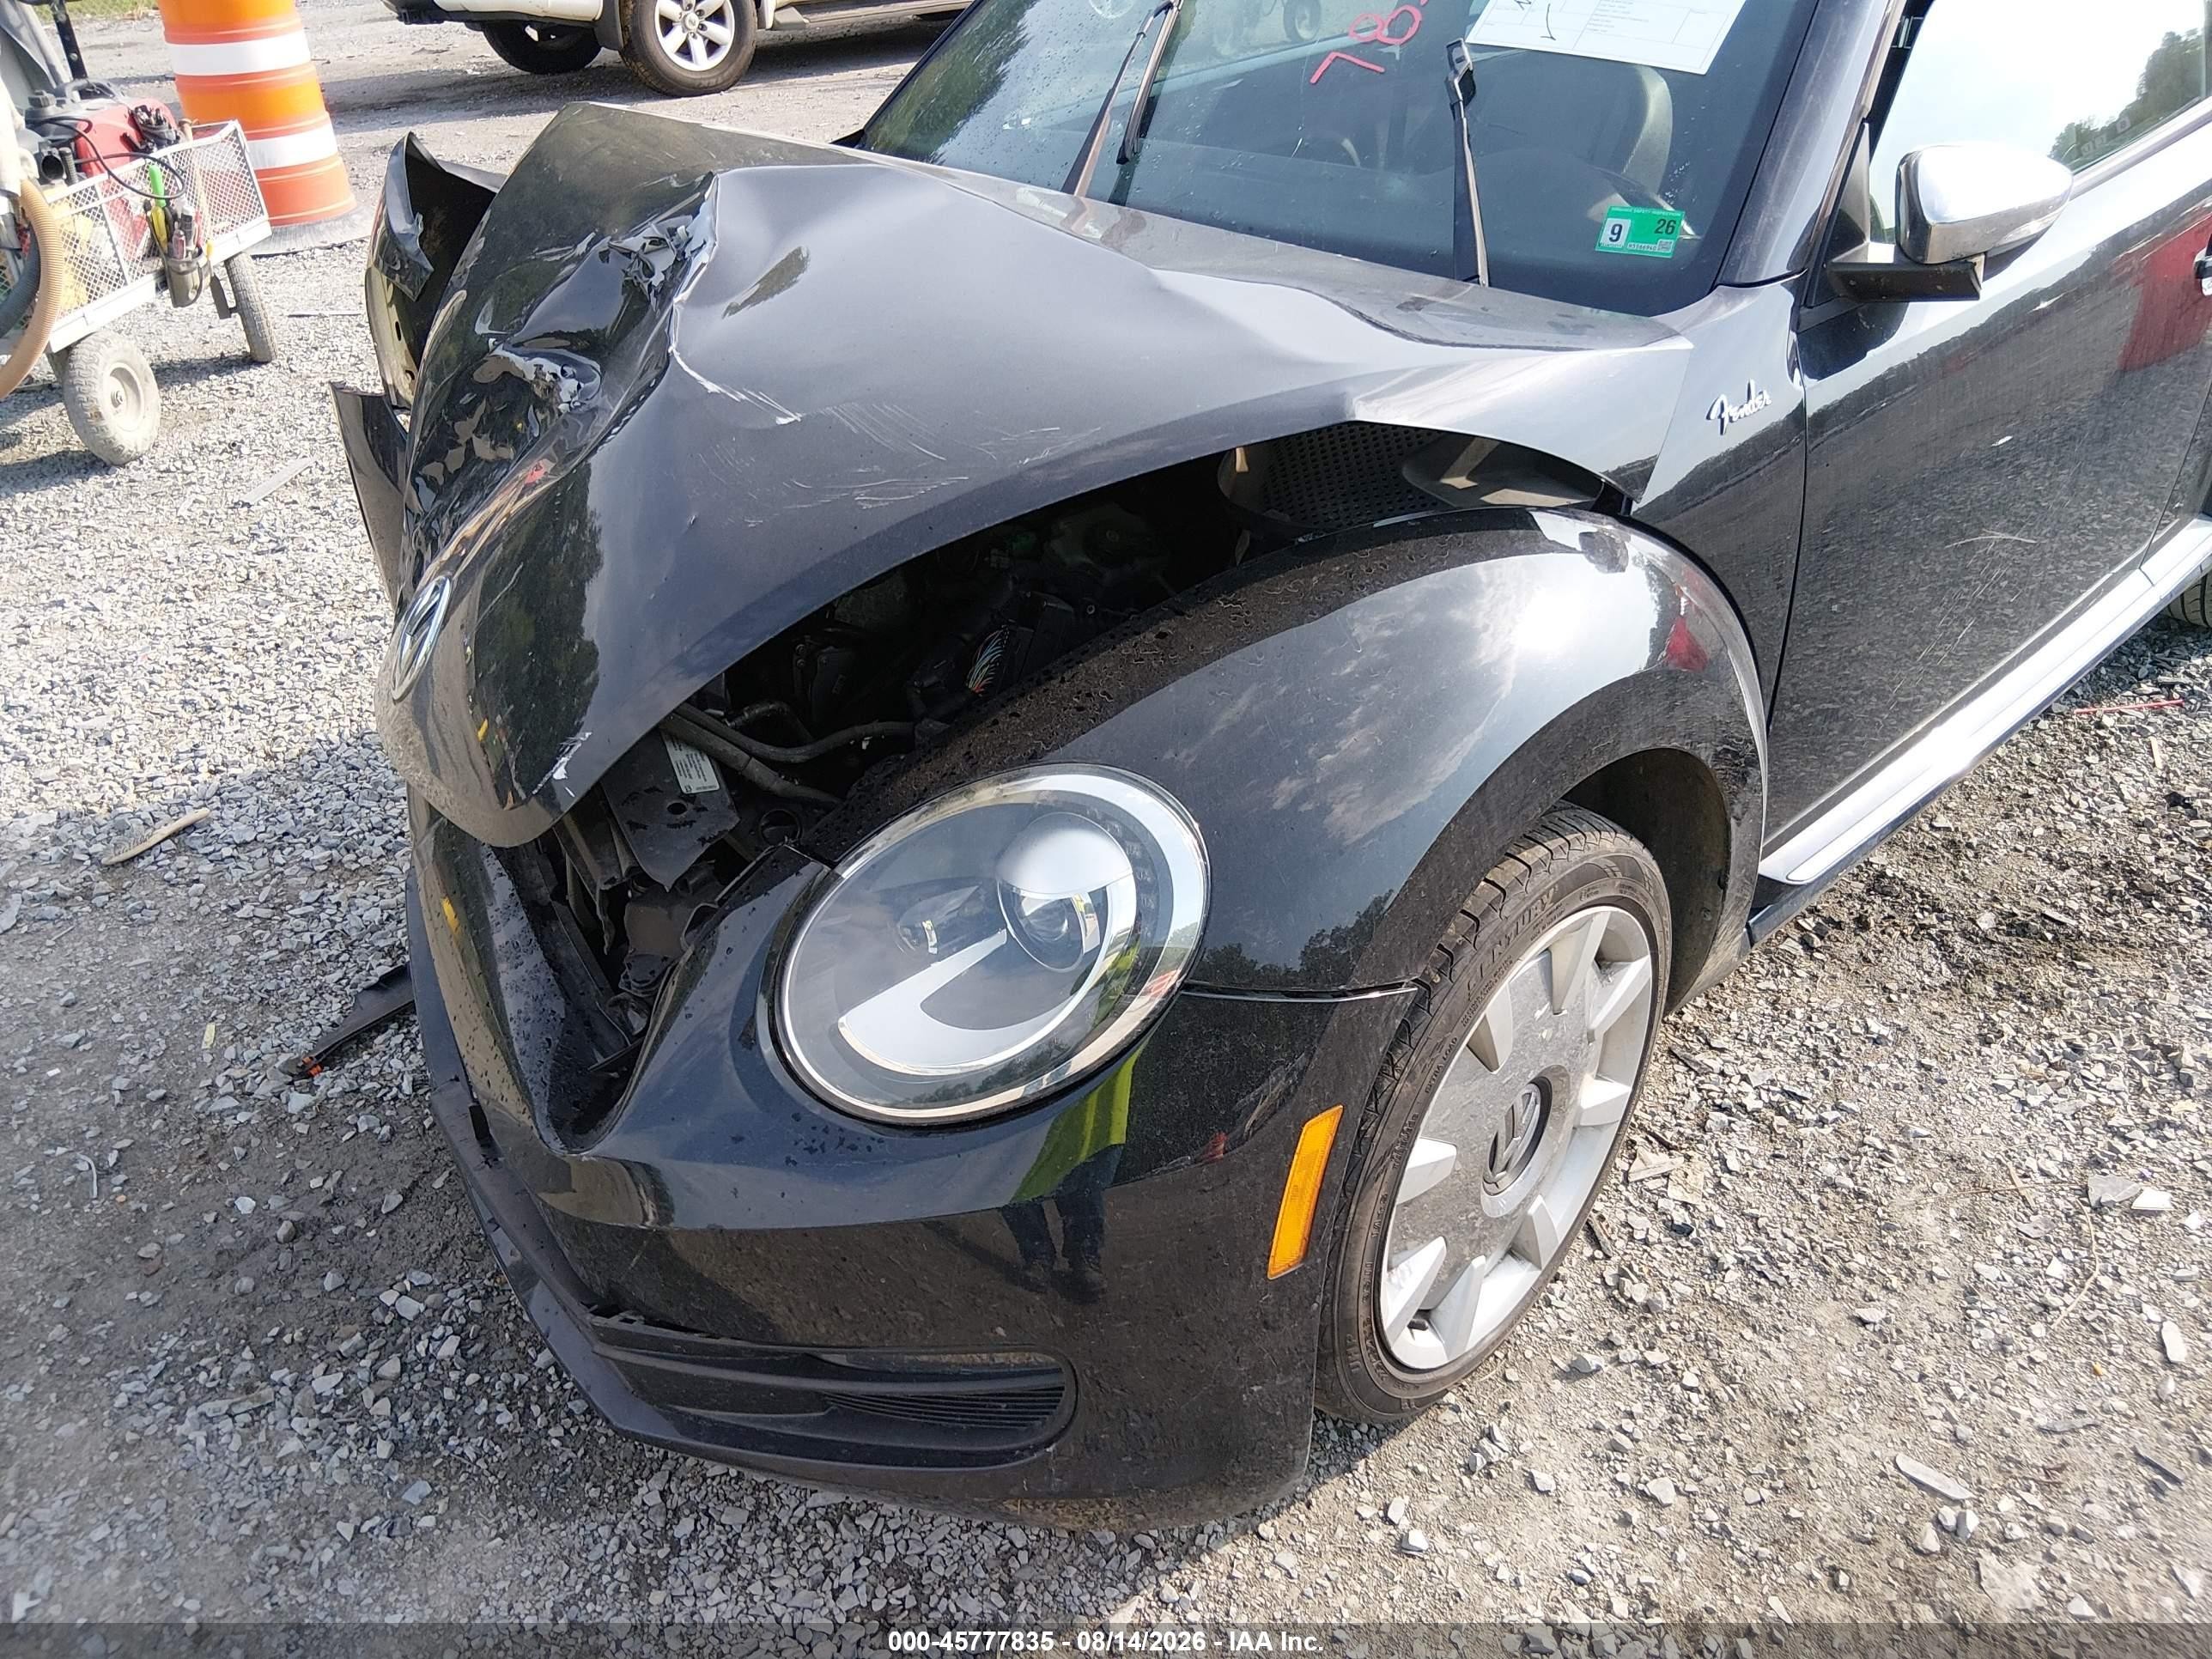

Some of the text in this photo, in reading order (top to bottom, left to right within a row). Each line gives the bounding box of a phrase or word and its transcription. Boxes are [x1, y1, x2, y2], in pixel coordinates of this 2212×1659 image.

[1608, 218, 1677, 242] 9 26
[1705, 378, 1772, 435] Fender
[1443, 1036, 1457, 1061] LOAD
